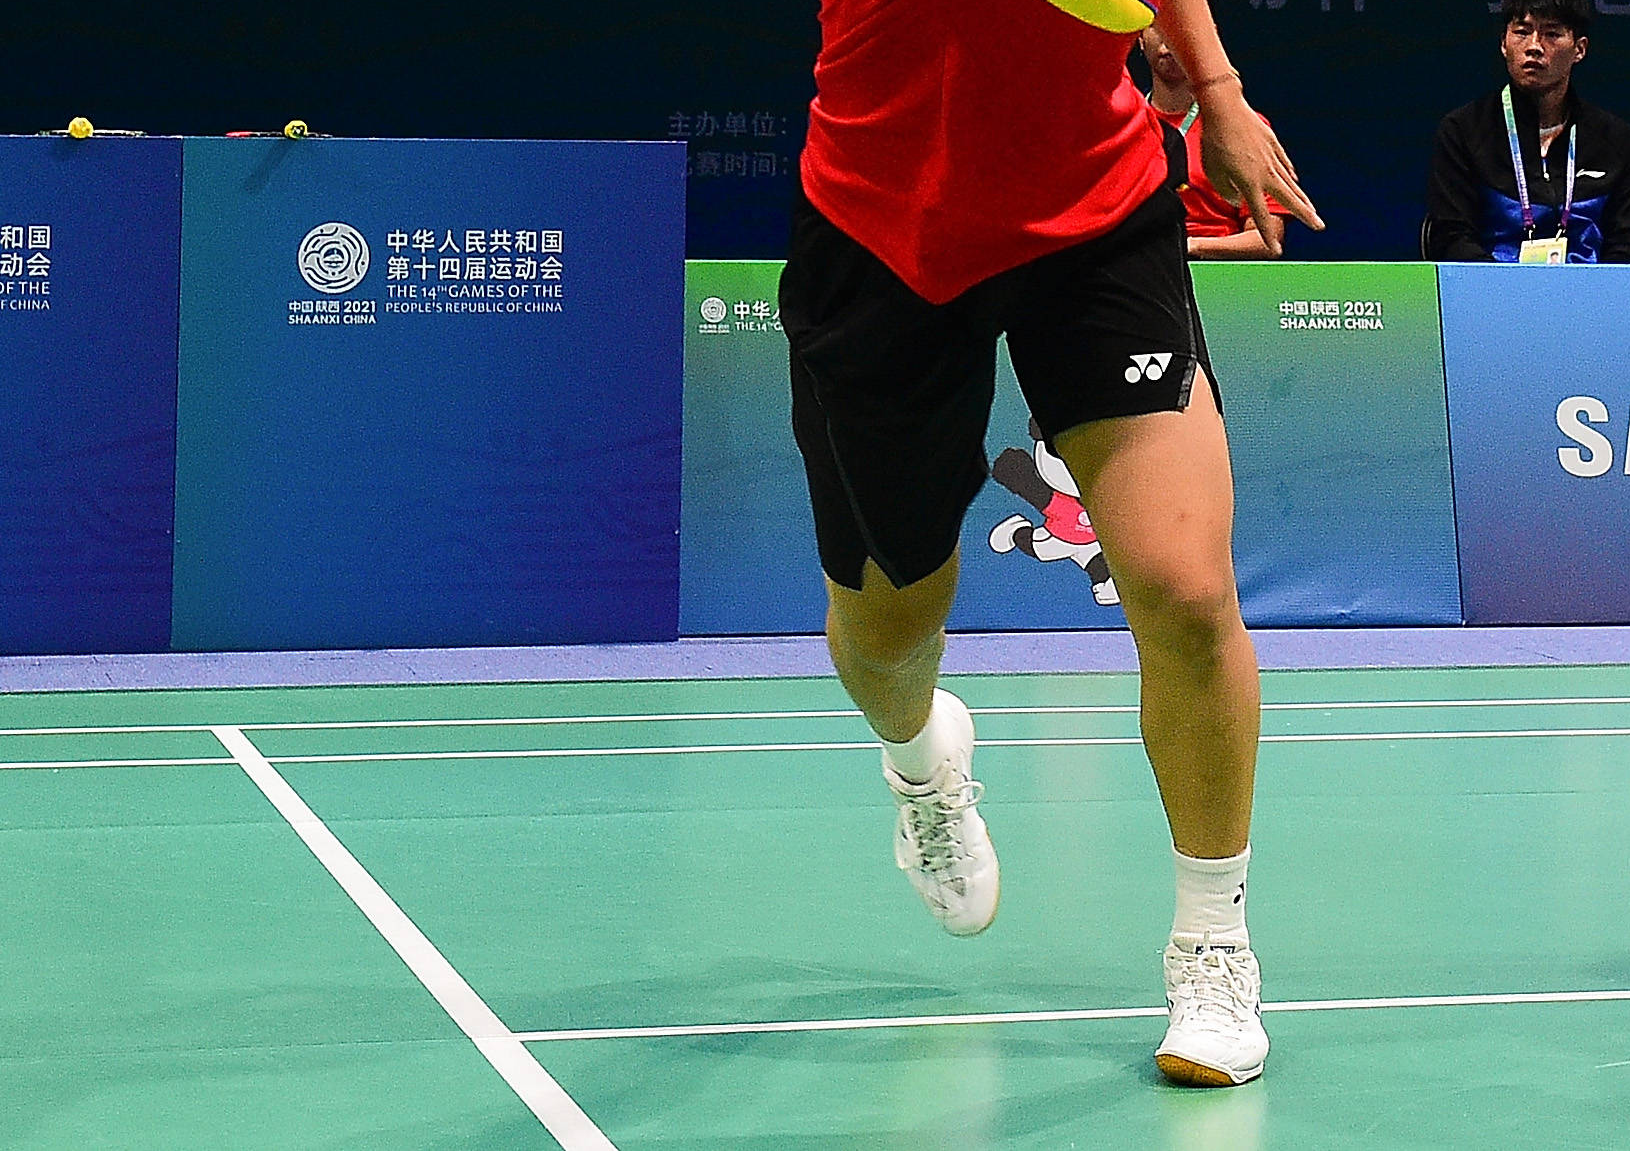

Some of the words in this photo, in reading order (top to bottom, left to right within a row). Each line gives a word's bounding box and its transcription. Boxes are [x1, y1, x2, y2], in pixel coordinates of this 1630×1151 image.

[0, 225, 51, 249] 和国
[386, 229, 564, 254] 中华人民共和国
[386, 256, 564, 281] 第十四届运动会
[18, 281, 50, 295] THE
[386, 284, 418, 298] THE
[508, 284, 529, 298] OF
[532, 284, 563, 298] THE
[9, 299, 50, 310] CHINA
[343, 300, 376, 313] 2021
[385, 301, 443, 313] PEOPLE'S
[445, 301, 501, 313] REPUBLIC
[505, 302, 523, 313] OF
[524, 302, 563, 313] CHINA
[1343, 301, 1382, 316] 2021
[288, 314, 340, 325] SHAANXI
[343, 314, 377, 325] CHINA
[1279, 318, 1341, 329] SHAANXI
[1344, 318, 1384, 330] CHINA
